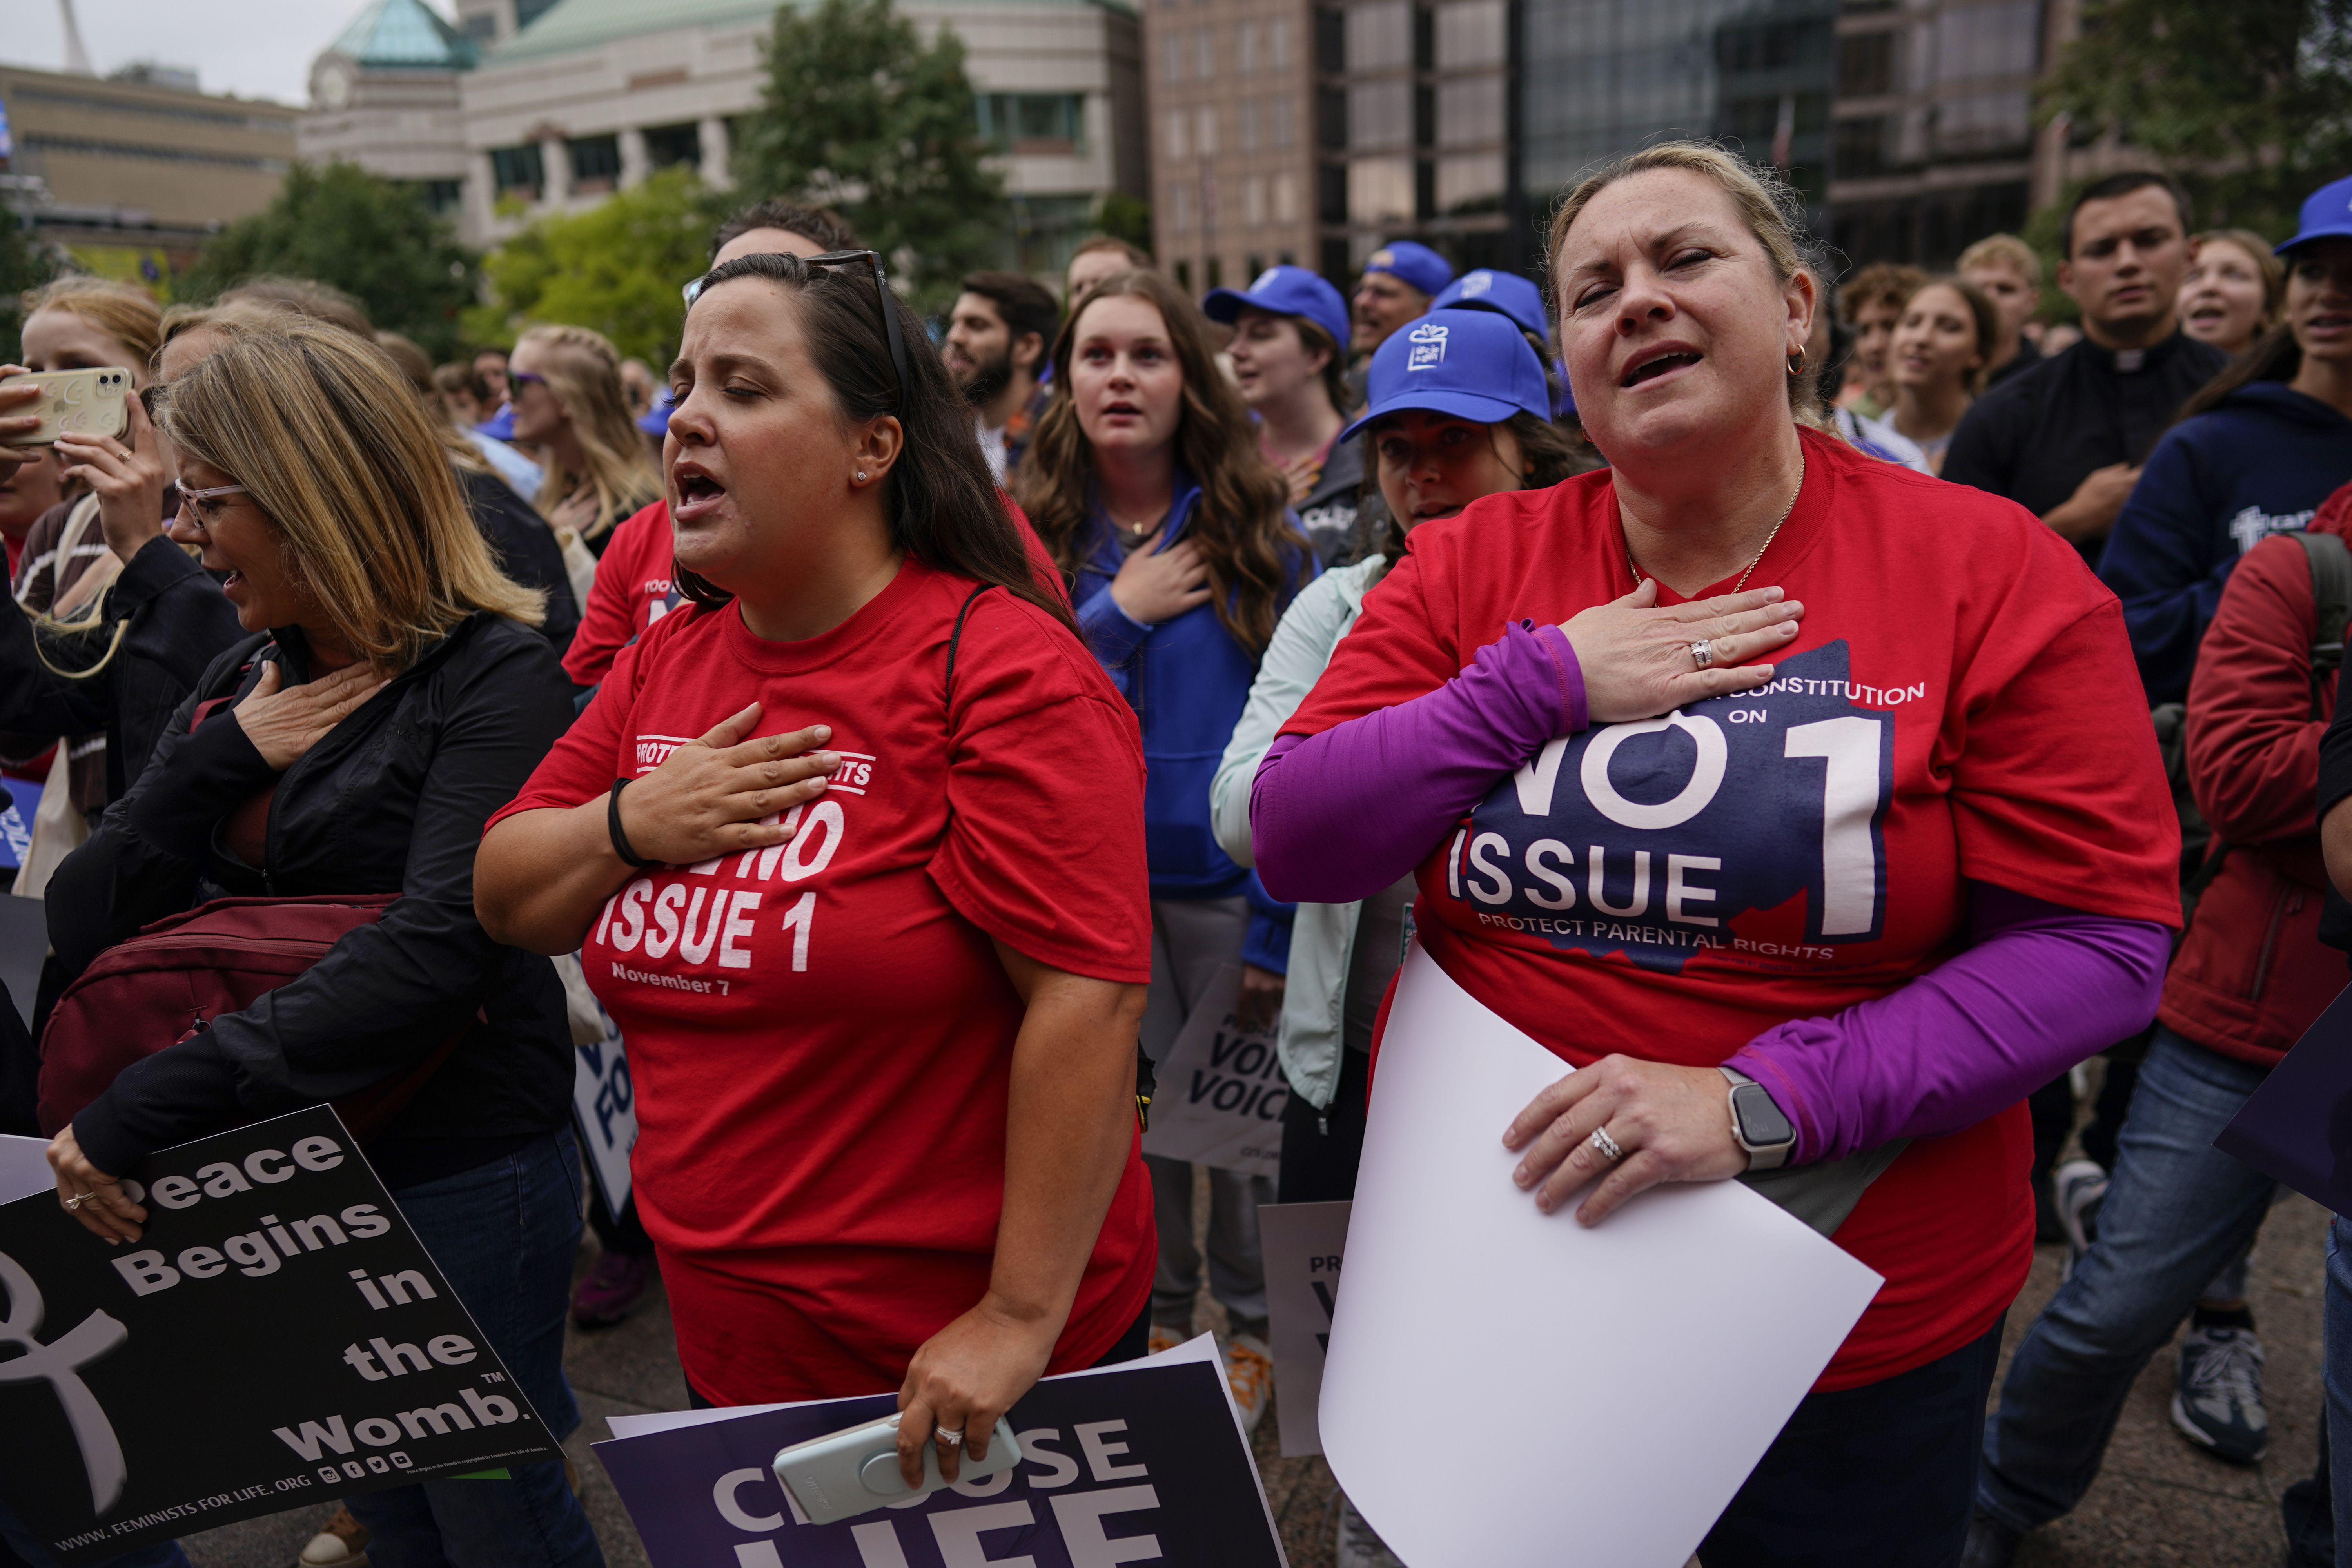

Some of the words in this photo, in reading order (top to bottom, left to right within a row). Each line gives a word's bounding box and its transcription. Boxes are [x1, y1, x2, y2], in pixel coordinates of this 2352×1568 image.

[1728, 709, 1767, 724] ON
[637, 742, 681, 764] PROT
[827, 759, 872, 785] HTS
[736, 800, 844, 882] NO
[1784, 715, 1882, 936] 1
[1448, 828, 1722, 928] ISSUE
[596, 878, 763, 969] ISSUE
[782, 892, 817, 972] 1
[1478, 913, 1585, 936] PROTECT
[1593, 921, 1726, 949] PARENTAL
[1733, 938, 1834, 960] RIGHTS
[612, 962, 712, 993] November
[717, 980, 730, 996] 7
[594, 1053, 632, 1152] FO
[1189, 1069, 1286, 1122] VOIC
[110, 1203, 391, 1298] Begins
[348, 1268, 438, 1310] in
[342, 1333, 478, 1381] the
[481, 1371, 506, 1385] TM
[272, 1387, 531, 1462] Womb.
[462, 1455, 485, 1465] copyrighted
[713, 1418, 1149, 1532] CSE
[54, 1528, 111, 1552] WWW.
[111, 1502, 198, 1536] FEMINISTS
[198, 1494, 234, 1511] FOR
[232, 1484, 274, 1502] LIFE.
[275, 1474, 312, 1491] ORG
